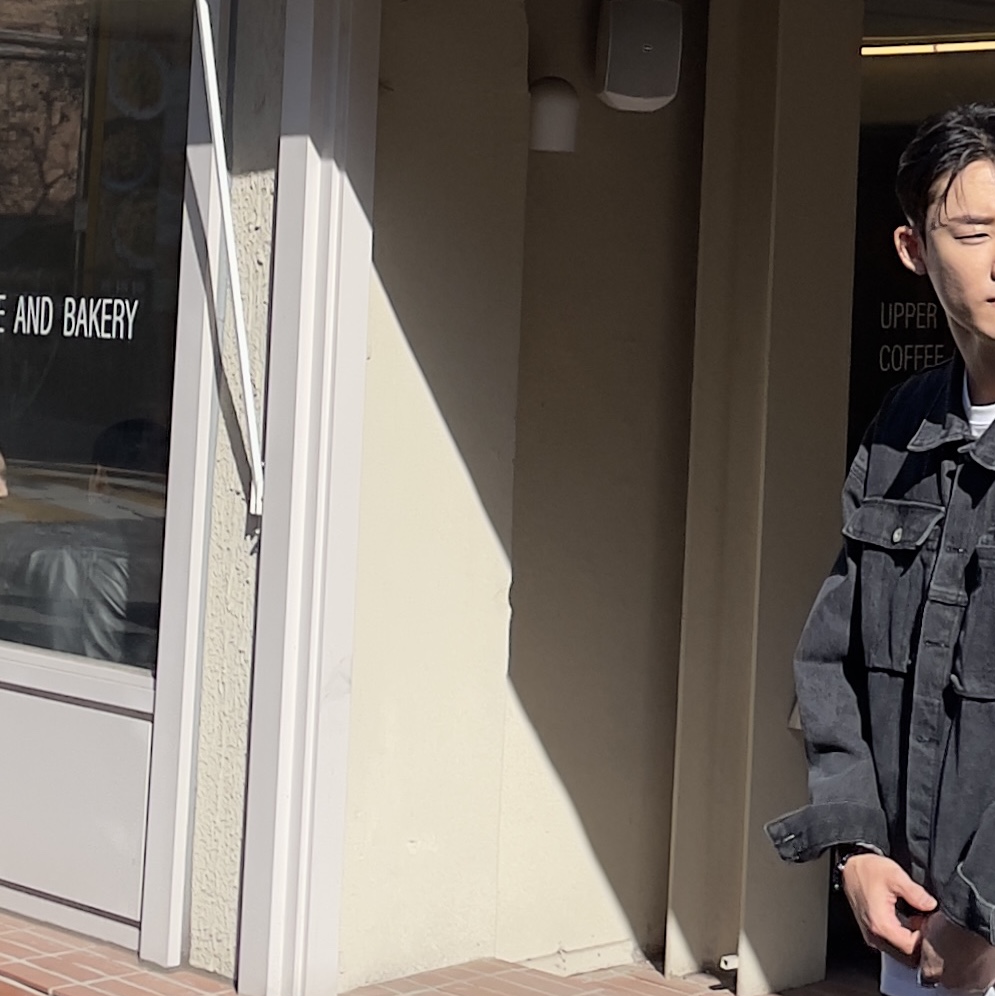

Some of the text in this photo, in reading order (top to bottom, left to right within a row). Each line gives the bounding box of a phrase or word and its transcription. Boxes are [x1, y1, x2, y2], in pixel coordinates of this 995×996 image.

[13, 295, 54, 335] AND
[63, 296, 139, 340] BAKERY
[881, 302, 937, 329] UPPER
[879, 344, 944, 372] COFFEE
